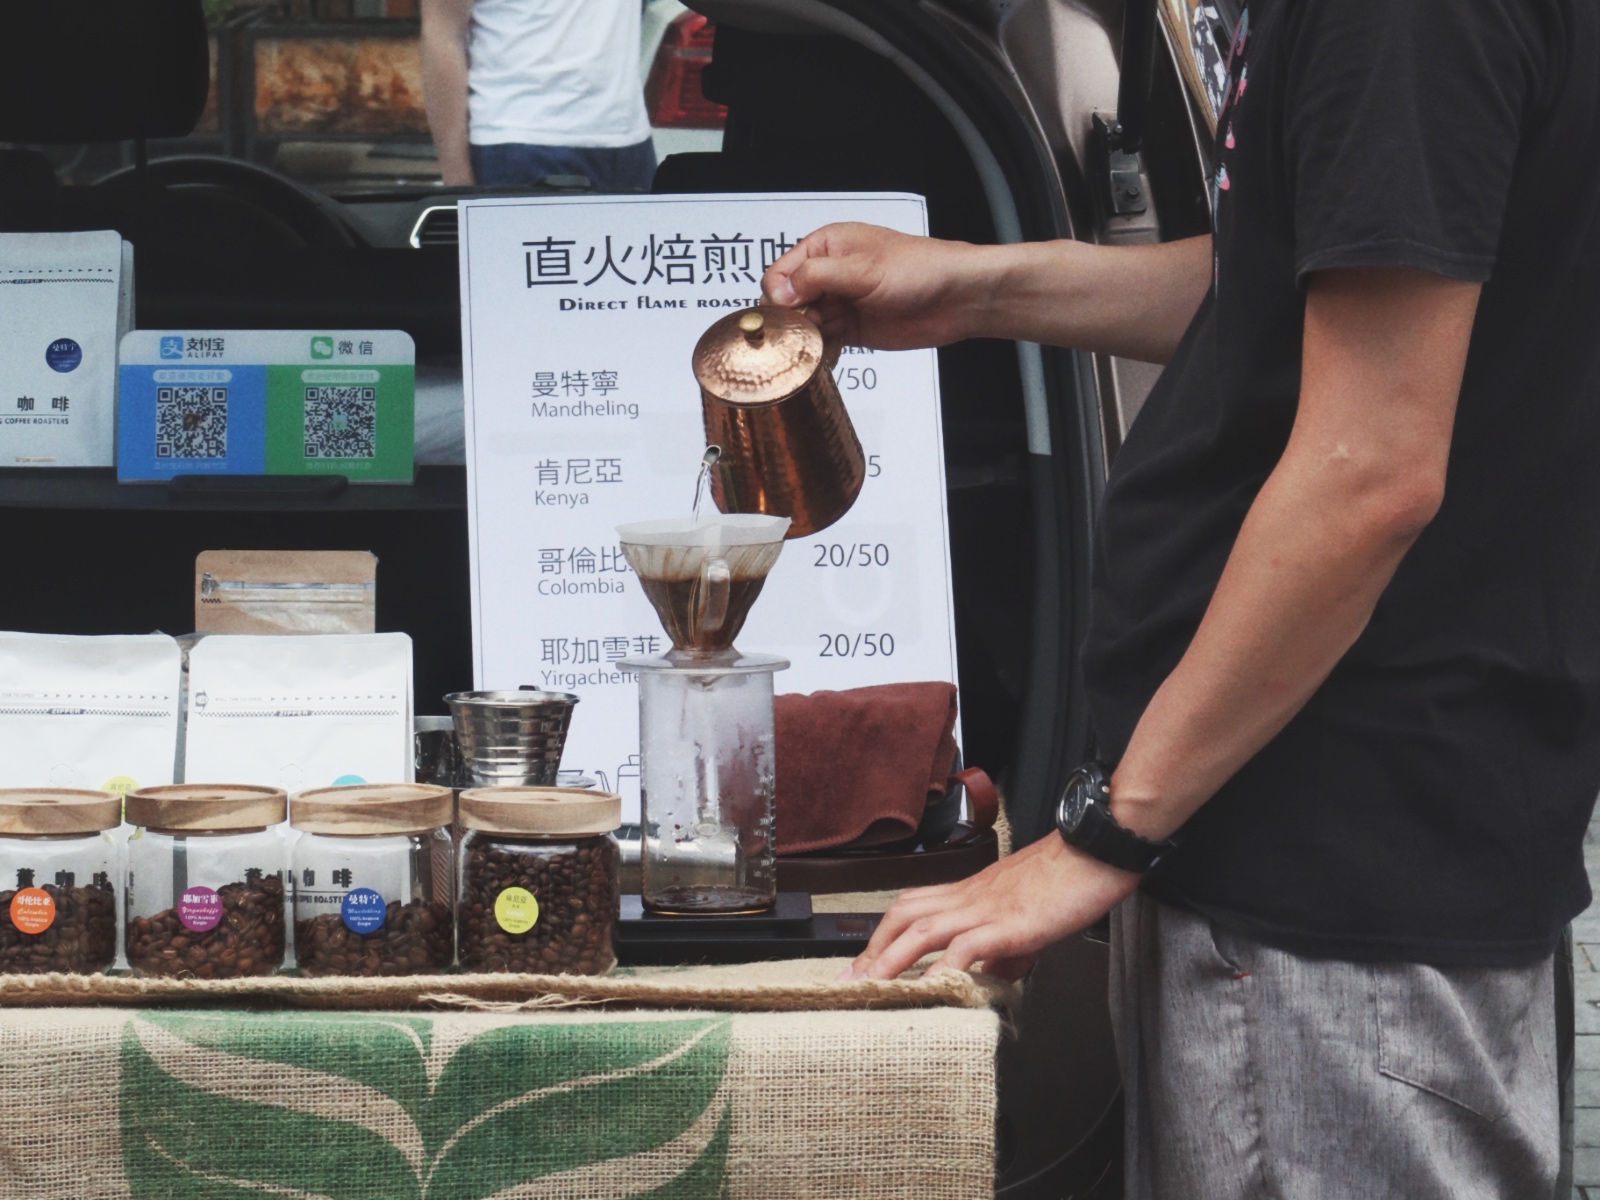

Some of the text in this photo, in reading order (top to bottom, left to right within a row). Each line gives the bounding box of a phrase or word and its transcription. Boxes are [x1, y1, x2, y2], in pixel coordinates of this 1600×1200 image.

[697, 298, 761, 308] ROASTE
[187, 338, 225, 351] 支付宝
[338, 340, 374, 355] 微信
[532, 370, 619, 397] 曼特寧
[836, 367, 877, 390] /50
[532, 400, 639, 419] Mandheling
[534, 459, 623, 485] 肯尼亞
[535, 490, 589, 509] Kenya
[538, 546, 634, 574] 哥倫比
[813, 543, 889, 568] 20/50
[538, 578, 625, 595] Colombia
[818, 633, 895, 658] 20/50
[314, 895, 344, 904] ROASTE
